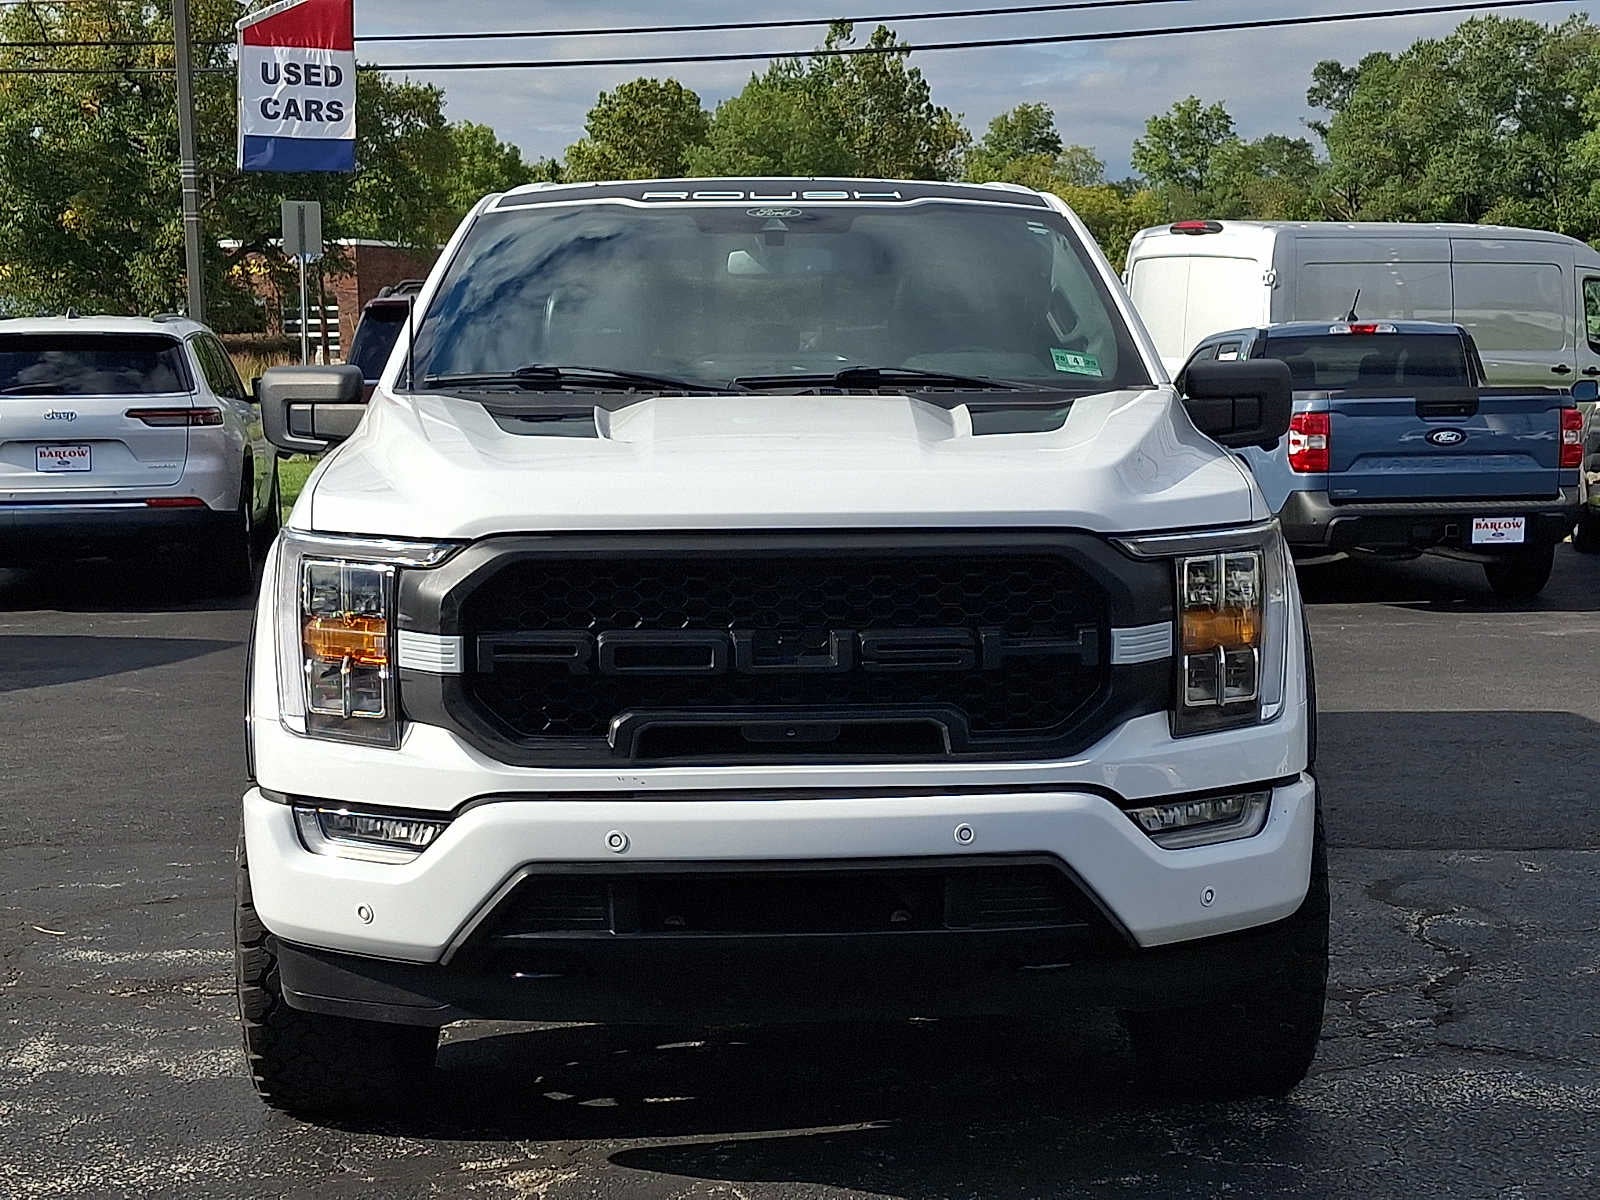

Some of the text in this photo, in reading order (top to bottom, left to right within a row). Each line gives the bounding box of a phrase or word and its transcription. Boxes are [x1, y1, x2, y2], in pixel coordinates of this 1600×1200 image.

[261, 62, 343, 87] USED
[260, 97, 344, 122] CARS
[641, 191, 902, 200] ROUSH
[753, 207, 796, 218] Ford
[1434, 431, 1460, 443] Ford
[39, 450, 88, 460] BARLOW
[1475, 521, 1523, 532] BARLOW
[476, 628, 1100, 674] ROUSH
